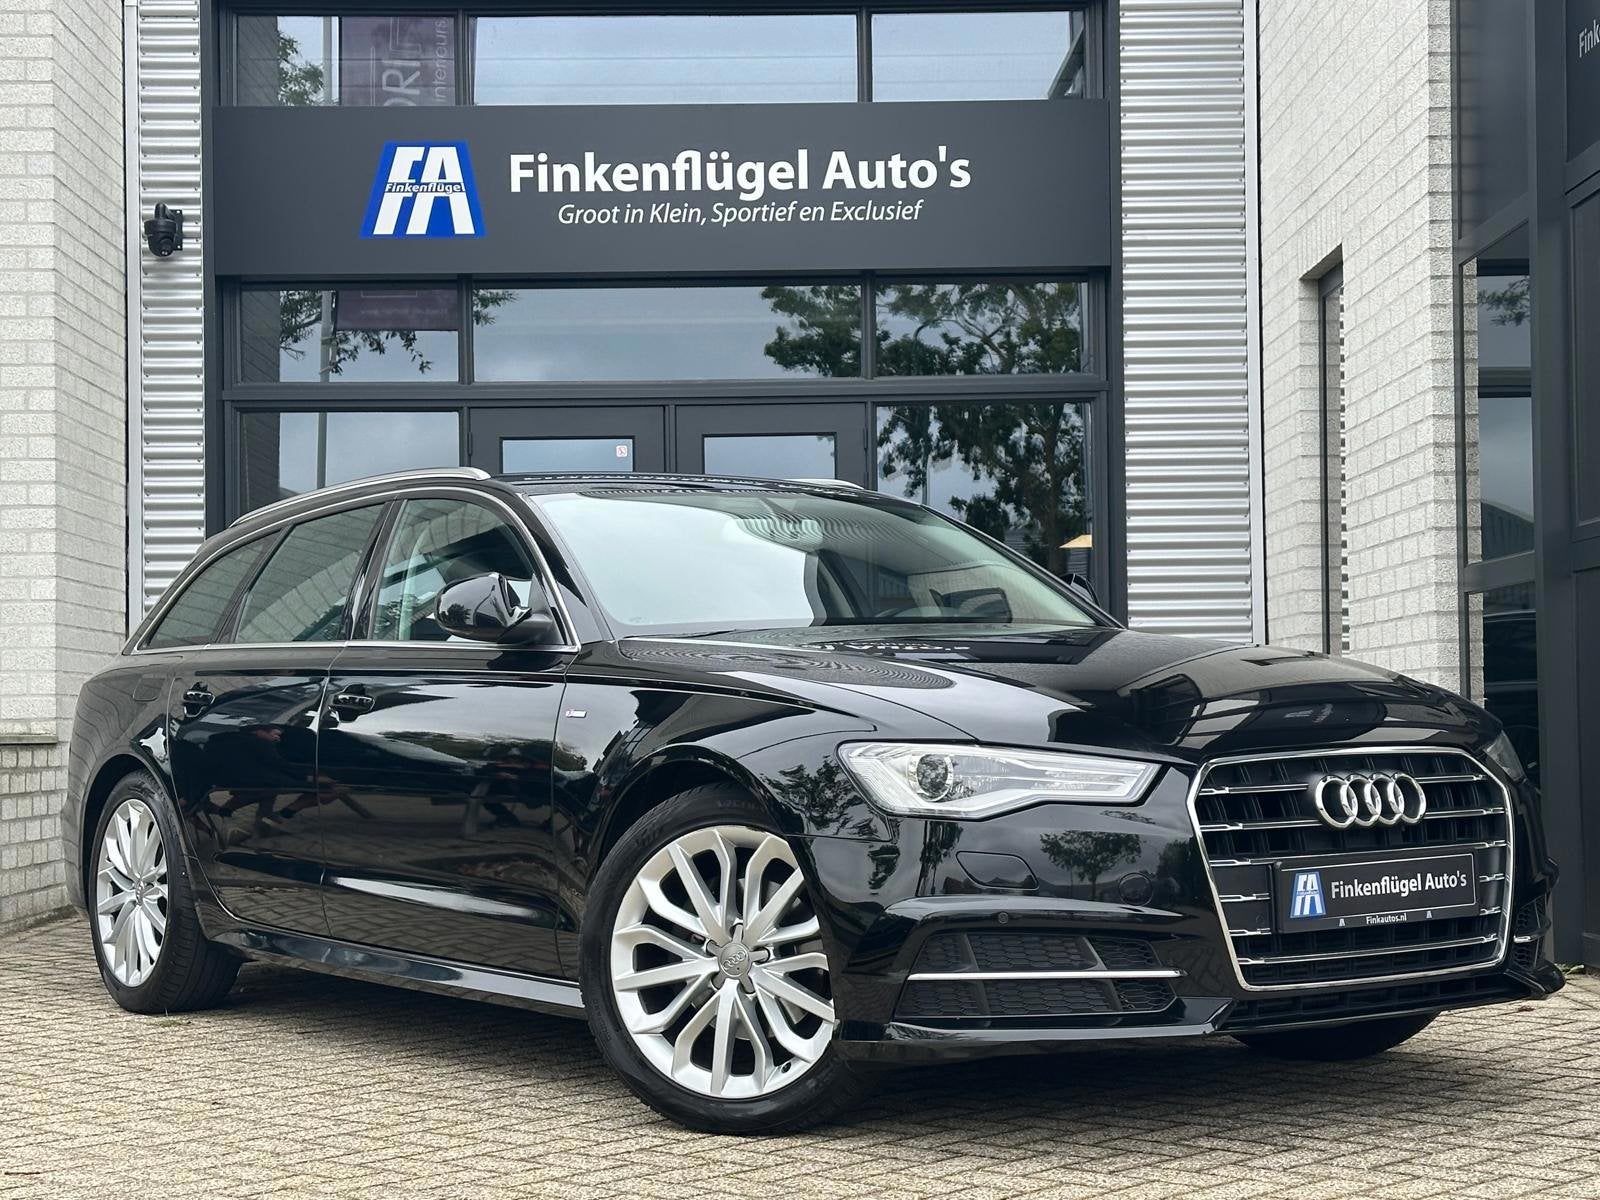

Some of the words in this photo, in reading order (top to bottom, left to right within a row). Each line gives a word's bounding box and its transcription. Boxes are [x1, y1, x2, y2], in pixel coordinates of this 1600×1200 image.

[1579, 19, 1600, 58] Fink
[511, 149, 808, 201] Finkenflügel
[822, 146, 971, 189] Auto's
[386, 182, 465, 195] Finkenflügel
[558, 204, 620, 224] Groot
[624, 203, 643, 223] in
[650, 203, 706, 226] Klein,
[711, 201, 797, 228] Sportief
[800, 206, 825, 222] en
[831, 199, 924, 222] Exclusief
[1331, 873, 1422, 899] Finkenflügel
[1425, 870, 1467, 890] Auto's
[1366, 912, 1407, 925] Finkautos.nl
